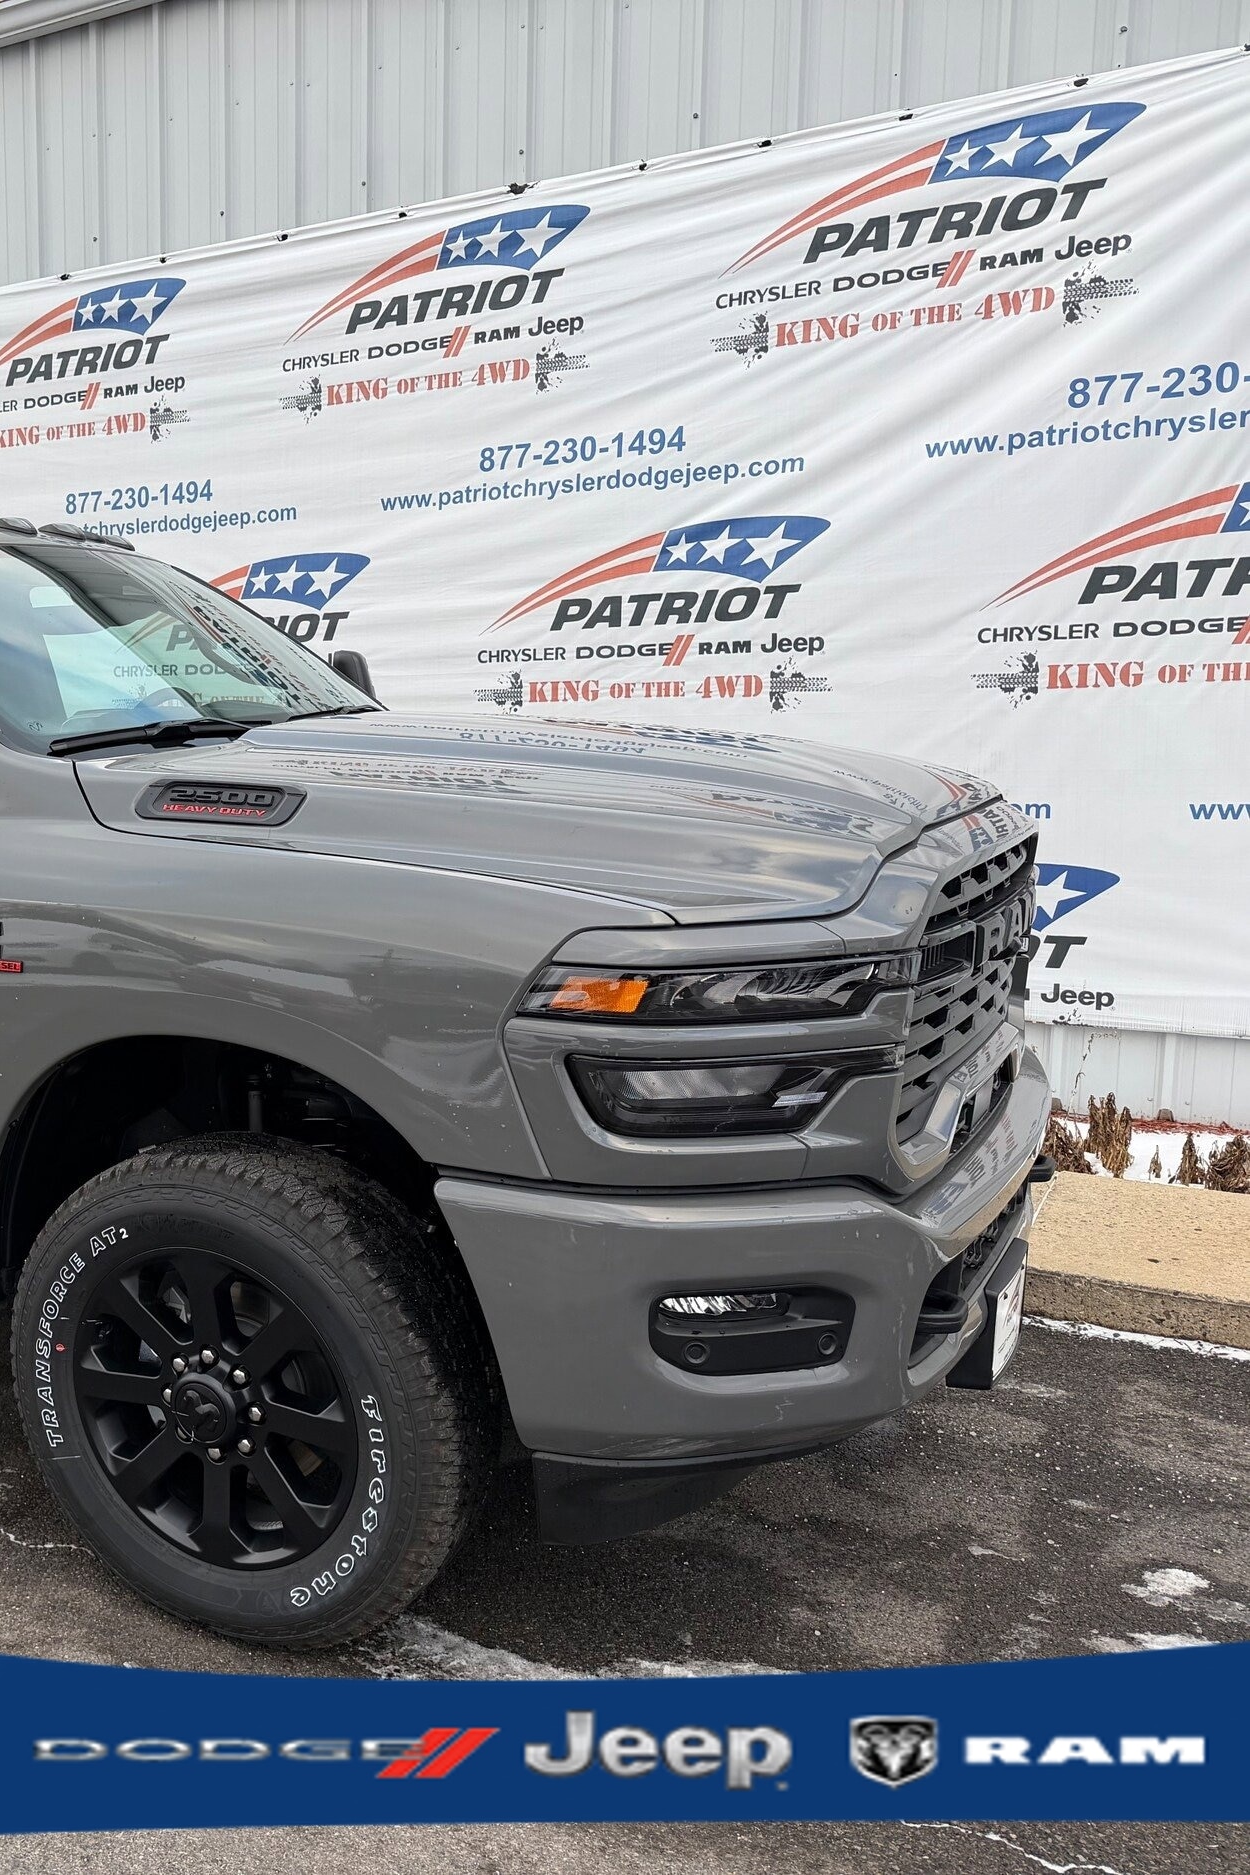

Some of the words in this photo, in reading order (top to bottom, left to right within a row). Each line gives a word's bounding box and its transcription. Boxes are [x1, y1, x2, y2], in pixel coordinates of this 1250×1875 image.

[802, 178, 1108, 265] PATRIOT
[715, 281, 822, 310] CHRYSLER
[832, 262, 949, 293] DODGE
[979, 248, 1044, 272] RAM
[1054, 233, 1133, 261] Jeep
[345, 268, 565, 335] PATRIOT
[775, 313, 861, 348] KING
[871, 311, 904, 333] OF
[910, 302, 962, 327] THE
[974, 285, 1056, 321] 4WD
[5, 334, 171, 387] PATRIOT
[282, 349, 360, 373] CHRYSLER
[368, 336, 453, 360] DODGE
[474, 325, 521, 345] RAM
[528, 315, 584, 337] Jeep
[24, 390, 88, 409] DODGE
[103, 383, 138, 399] RAM
[144, 376, 185, 393] Jeep
[326, 378, 388, 407] KING
[396, 376, 421, 395] OF
[424, 371, 463, 391] THE
[471, 358, 531, 387] 4WD
[46, 426, 63, 441] OF
[65, 421, 96, 439] THE
[102, 412, 146, 436] 4WD
[479, 425, 685, 473] 877-230-1494
[65, 479, 213, 515] 877-230-1494
[380, 455, 805, 512] www.patriotchryslerdodgejeep.com
[550, 583, 802, 632] PATRIOT
[477, 647, 566, 664] CHRYSLER
[575, 643, 674, 660] DODGE
[698, 640, 752, 655] RAM
[761, 633, 825, 656] Jeep
[977, 623, 1100, 644] CHRYSLER
[528, 679, 600, 703] KING
[609, 682, 637, 699] OF
[642, 681, 685, 698] THE
[695, 674, 763, 700] 4WD
[1046, 661, 1145, 690] KING
[1157, 664, 1194, 684] OF
[162, 803, 217, 815] HEAVY
[219, 806, 267, 817] DUTY
[170, 788, 276, 808] 2500
[1040, 983, 1115, 1011] Jeep
[35, 1253, 87, 1449] TRANSFORCE
